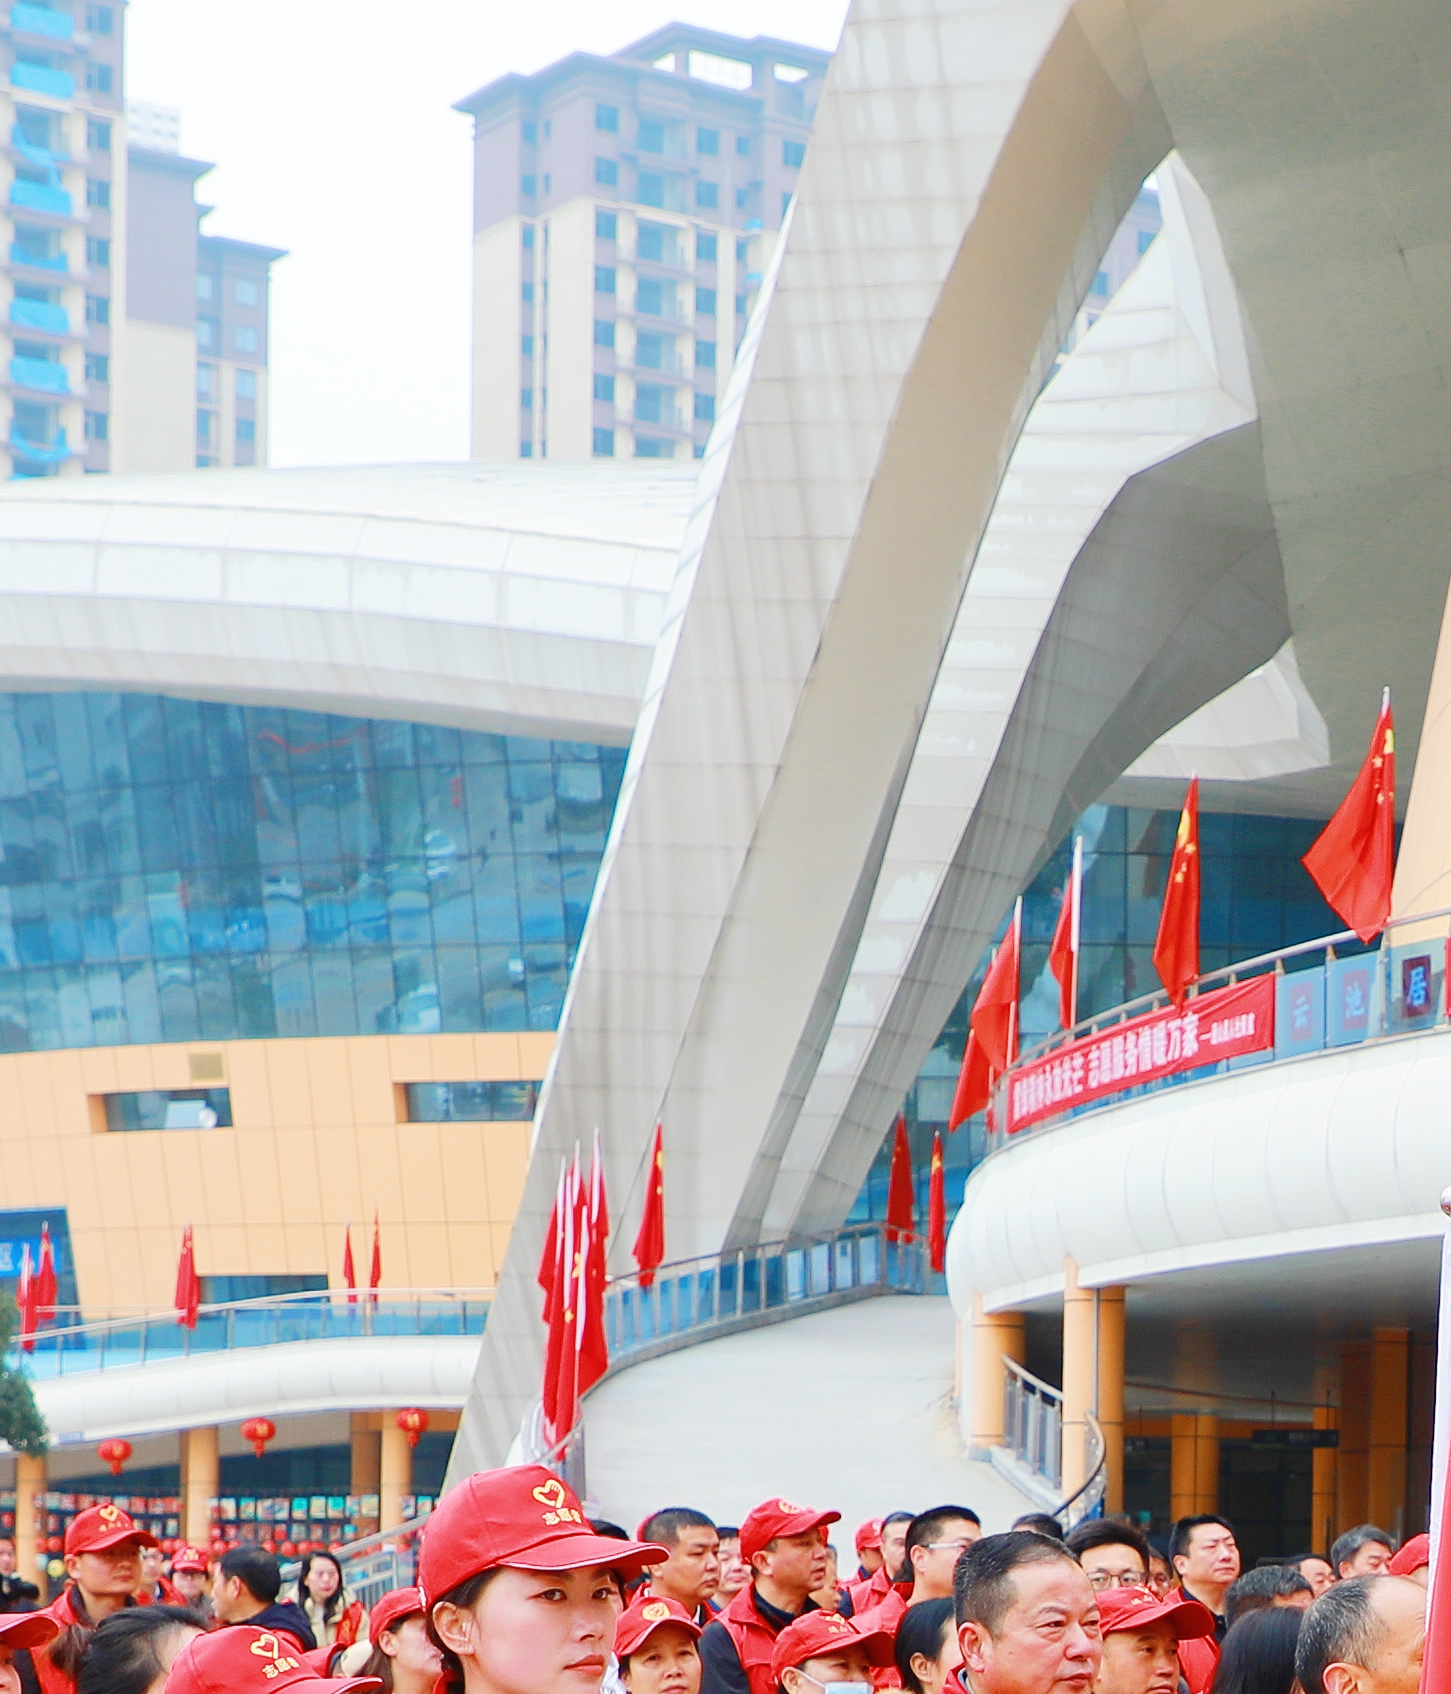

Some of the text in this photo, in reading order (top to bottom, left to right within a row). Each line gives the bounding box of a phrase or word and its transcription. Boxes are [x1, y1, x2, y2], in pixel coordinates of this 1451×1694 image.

[543, 1507, 582, 1526] 志愿者
[261, 1656, 300, 1680] 志愿者
